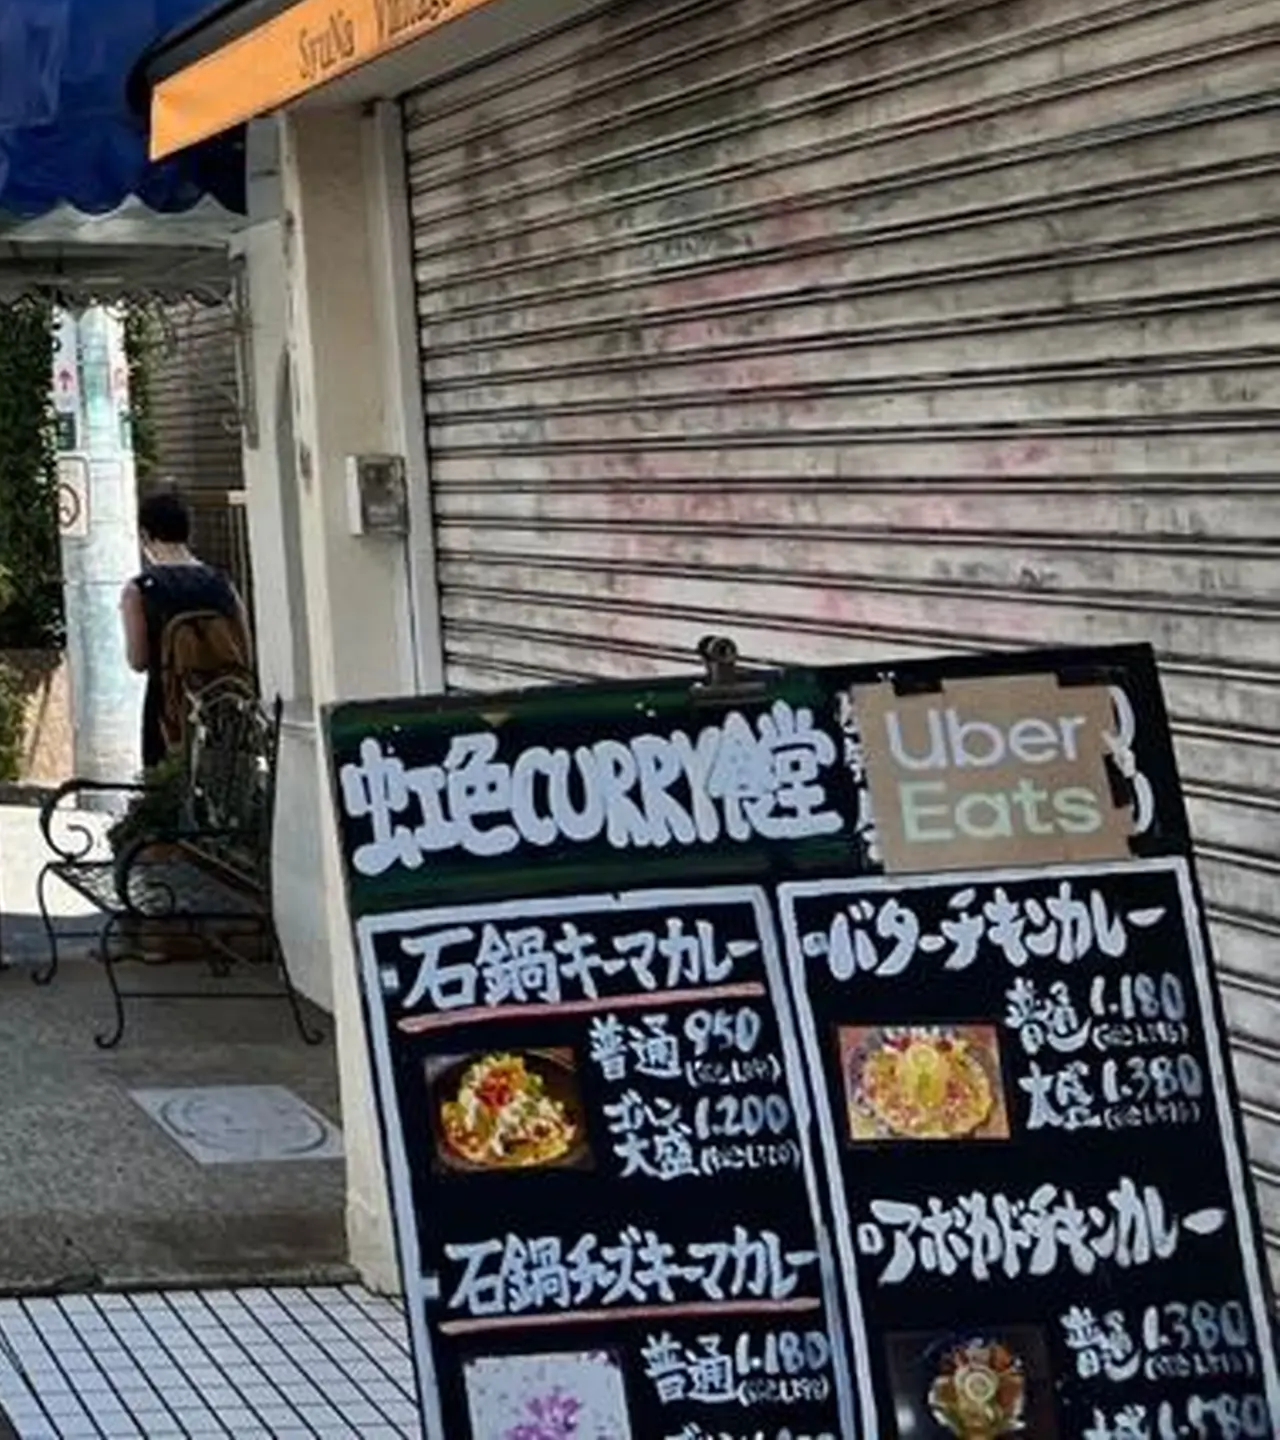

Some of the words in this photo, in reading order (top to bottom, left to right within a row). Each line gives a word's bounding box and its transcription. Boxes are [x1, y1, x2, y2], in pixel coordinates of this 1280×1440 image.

[884, 707, 1088, 771] Uber
[340, 699, 844, 876] 虹色CURRY食堂
[897, 778, 1104, 843] Eats
[400, 916, 761, 1011] 石鍋キーマカレー
[828, 881, 1167, 981] バターチキンカレー
[589, 1013, 682, 1082] 普通
[683, 1006, 761, 1057] 950
[1004, 976, 1092, 1056] 普通
[1017, 1059, 1102, 1130] 大盛
[612, 1131, 701, 1181] 大盛
[869, 1175, 1228, 1285] アボカドチキンカレー
[640, 1330, 738, 1407] 普通
[1059, 1305, 1142, 1383] 普通
